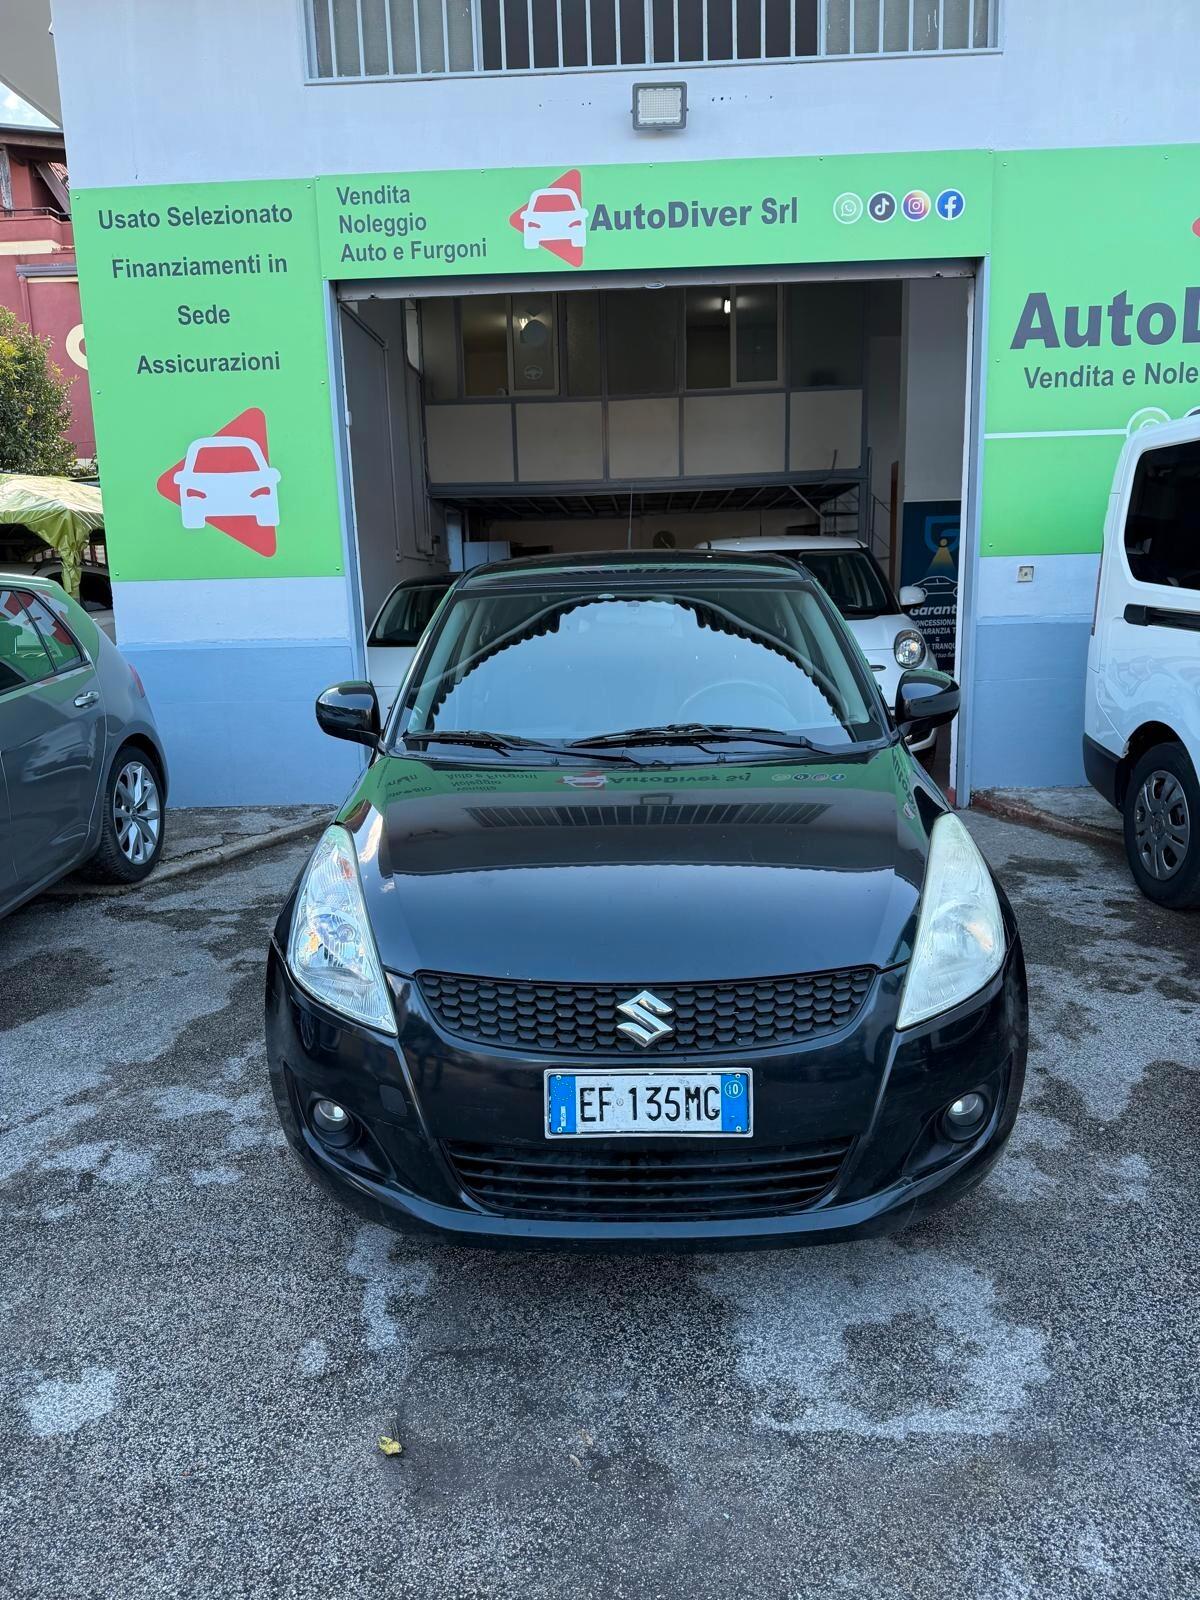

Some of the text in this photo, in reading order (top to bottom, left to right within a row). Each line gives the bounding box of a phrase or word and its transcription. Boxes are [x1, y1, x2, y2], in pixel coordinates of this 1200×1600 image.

[337, 185, 410, 205] Vendita
[98, 203, 293, 230] Usato Selezionato
[340, 212, 427, 238] Noleggio
[590, 196, 798, 231] AutoDiver Srl
[341, 238, 487, 264] Auto e Furgoni
[112, 254, 288, 279] Finanziamenti in
[177, 304, 231, 326] Sede
[136, 351, 281, 375] Assicurazioni
[1024, 362, 1199, 389] Vendita e Nole
[578, 1086, 613, 1122] EF
[628, 1086, 721, 1122] 135MG
